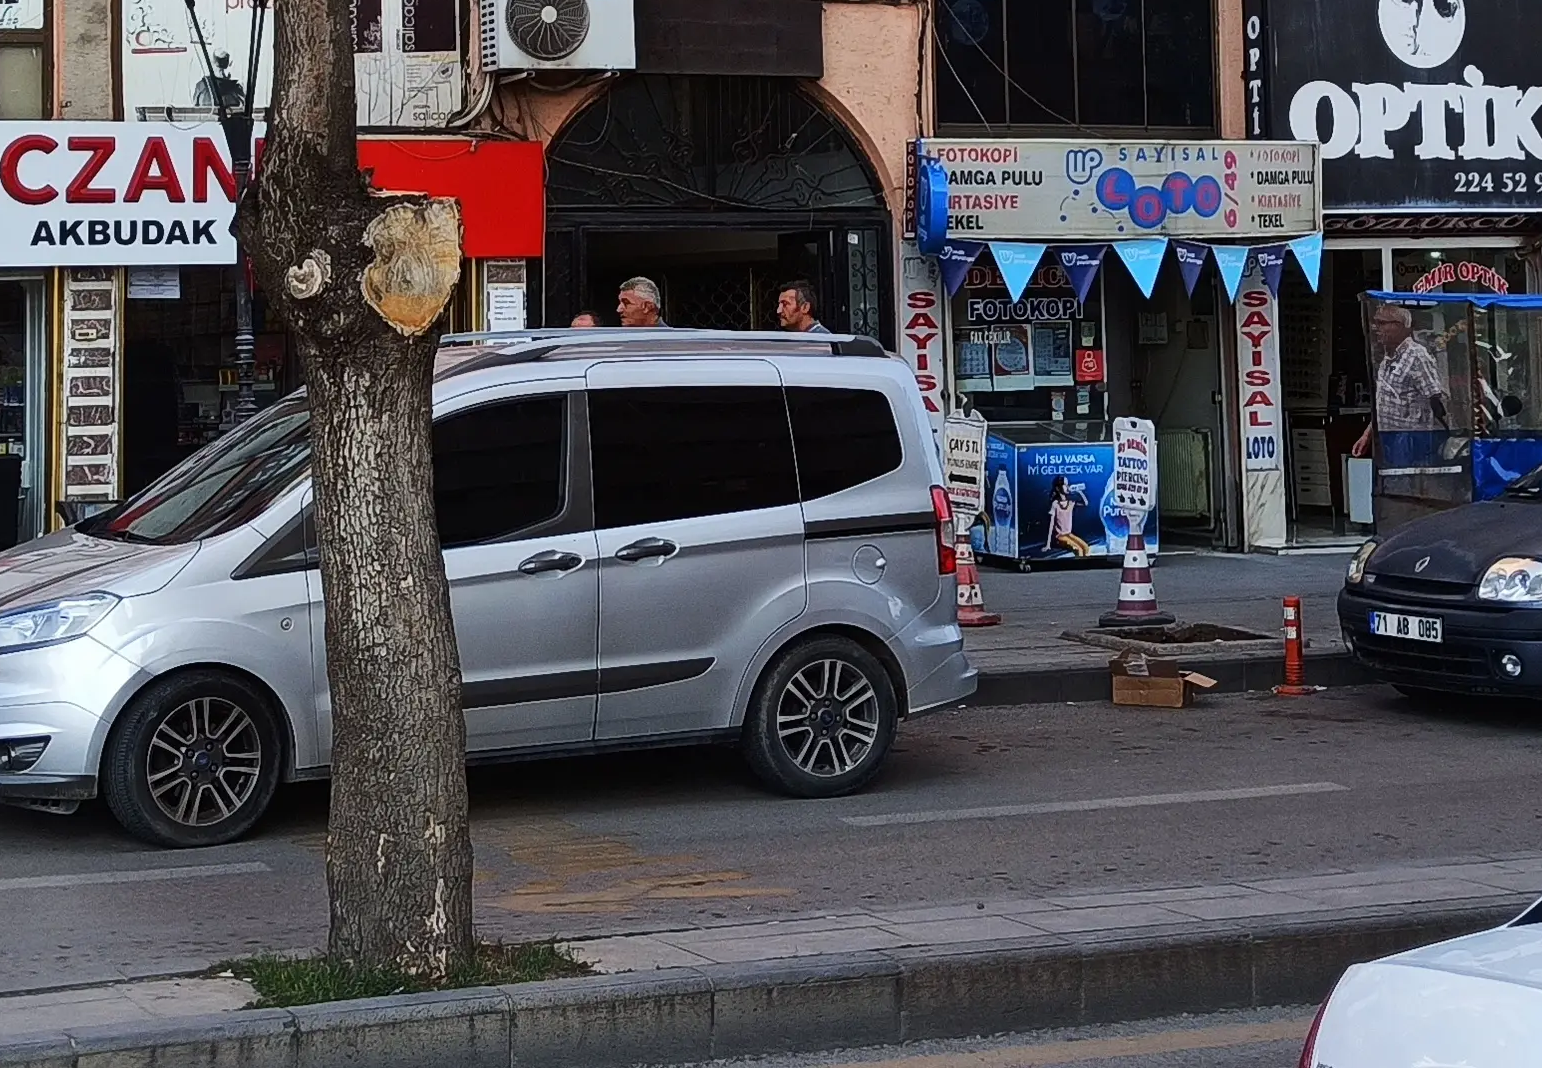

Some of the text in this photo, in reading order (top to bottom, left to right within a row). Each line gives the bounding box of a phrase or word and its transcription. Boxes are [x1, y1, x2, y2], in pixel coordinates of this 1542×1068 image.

[937, 147, 1017, 163] FOTOKOPİ
[1119, 147, 1219, 162] SAYISAL
[1002, 171, 1043, 185] PULU
[1257, 171, 1289, 184] DAMGA
[1454, 171, 1494, 193] 224
[1502, 171, 1527, 193] 52
[1258, 214, 1284, 228] TEKEL
[30, 219, 217, 248] AKBUDAK
[1241, 290, 1272, 427] SAYISAL
[949, 438, 964, 453] ÇAY
[1246, 436, 1275, 460] LOTO
[1036, 453, 1095, 464] İYİ SU VARSA
[1118, 456, 1147, 470] TATTOO
[1028, 464, 1103, 475] İYİ GELECEK VAR
[1375, 614, 1388, 633] 71
[1396, 617, 1409, 636] AB
